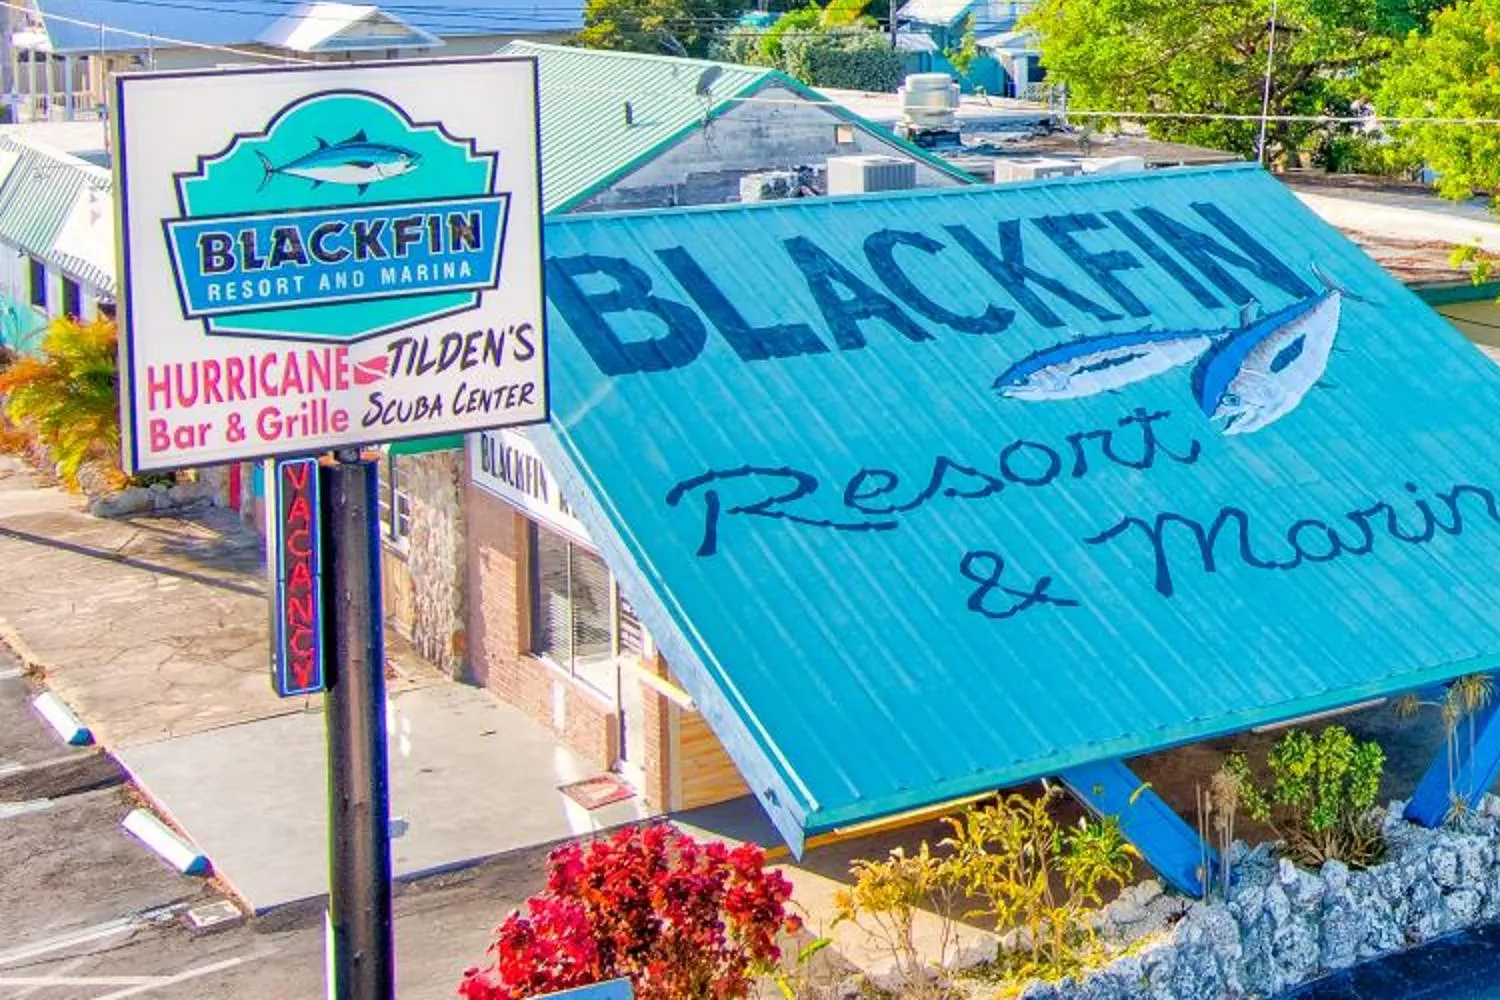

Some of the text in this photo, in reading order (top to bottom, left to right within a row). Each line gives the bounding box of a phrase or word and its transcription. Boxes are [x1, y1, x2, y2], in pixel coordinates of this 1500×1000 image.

[197, 211, 483, 276] BLACKFIN
[208, 261, 472, 302] RESORT AND MARINA
[546, 201, 1317, 377] BLACKFIN
[147, 347, 350, 411] HURRICANE
[387, 322, 536, 379] TILDEN'S
[148, 399, 350, 453] Bar & Grille
[362, 381, 535, 429] SCUBA CENTER
[481, 433, 549, 505] BLACKFIN
[665, 406, 1201, 557] Resort
[284, 462, 316, 689] VACANCY
[959, 550, 1081, 620] &
